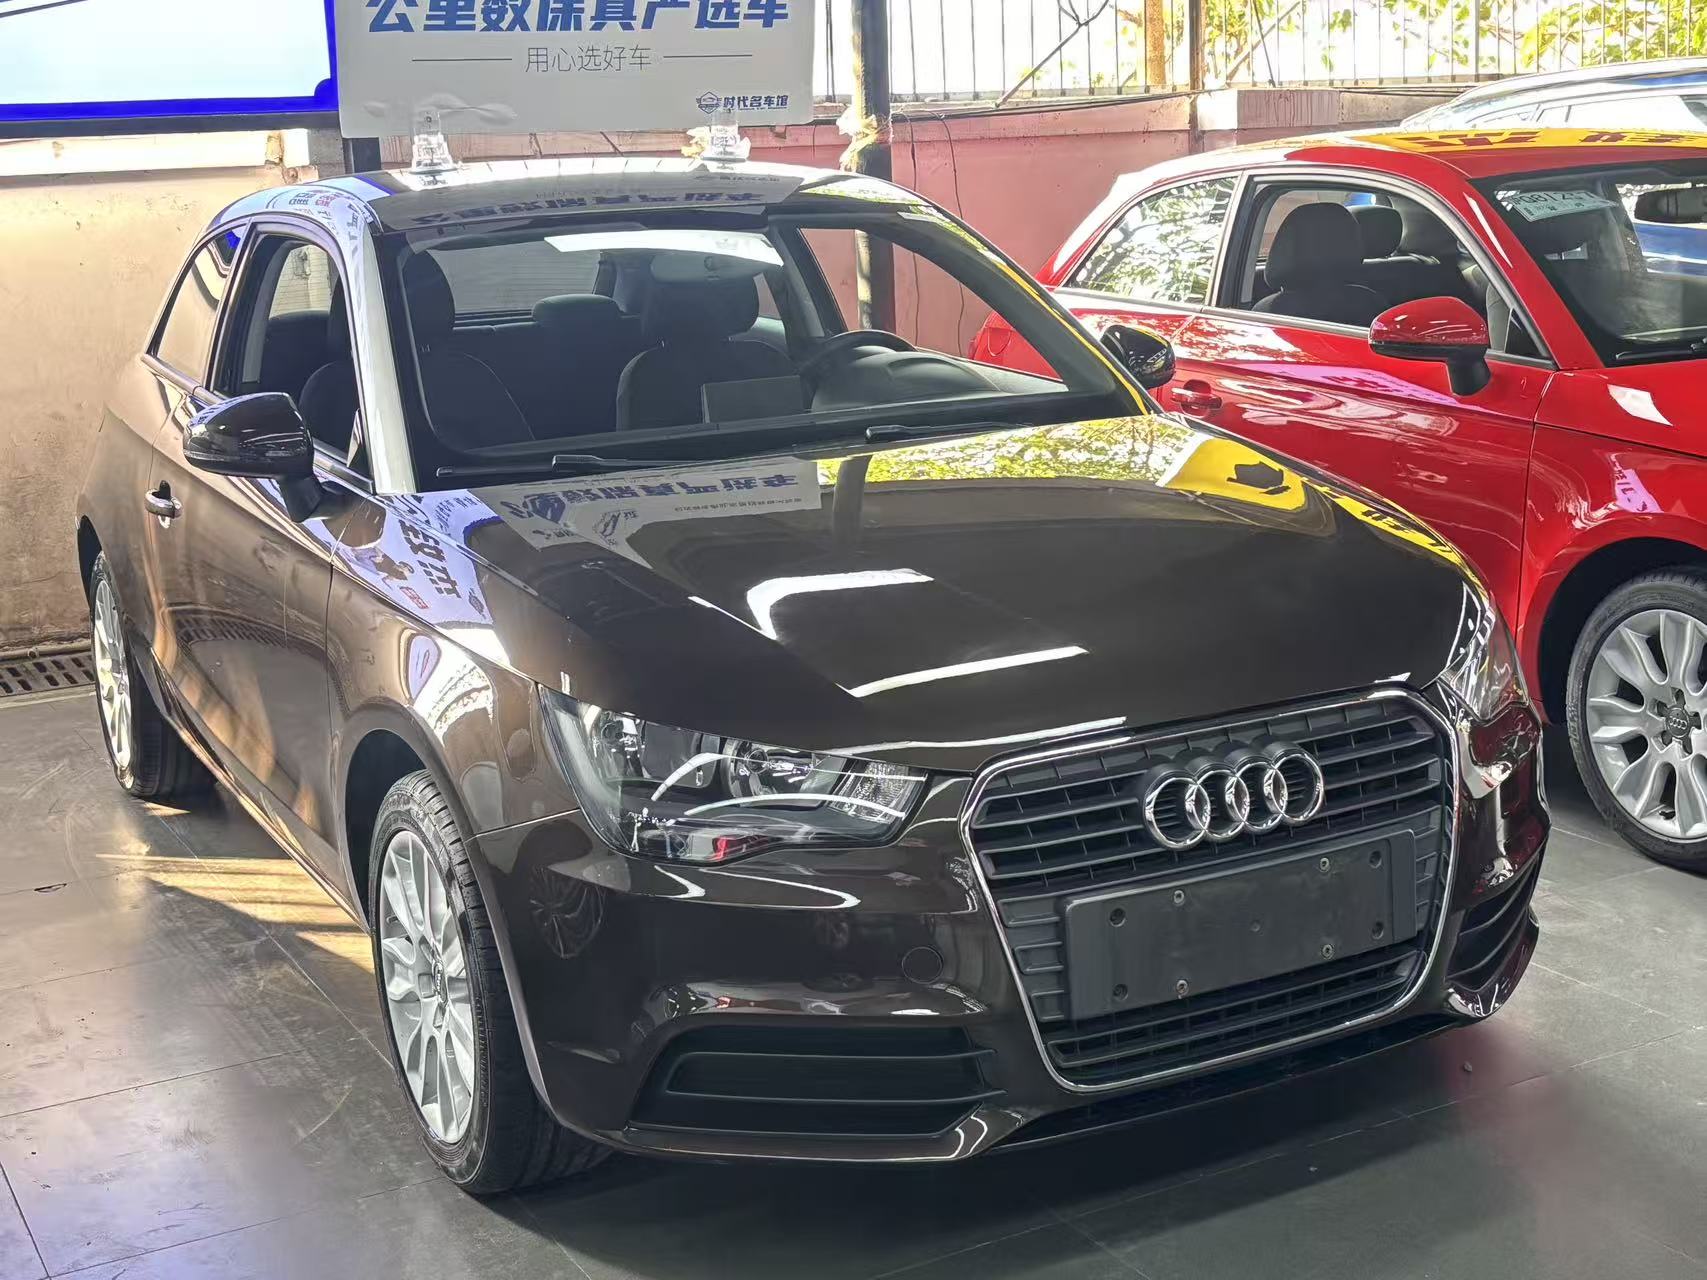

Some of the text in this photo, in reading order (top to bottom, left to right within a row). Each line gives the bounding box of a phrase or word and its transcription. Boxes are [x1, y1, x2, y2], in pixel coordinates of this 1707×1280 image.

[525, 45, 651, 73] 用心选好车
[723, 95, 789, 109] 时代名车馆
